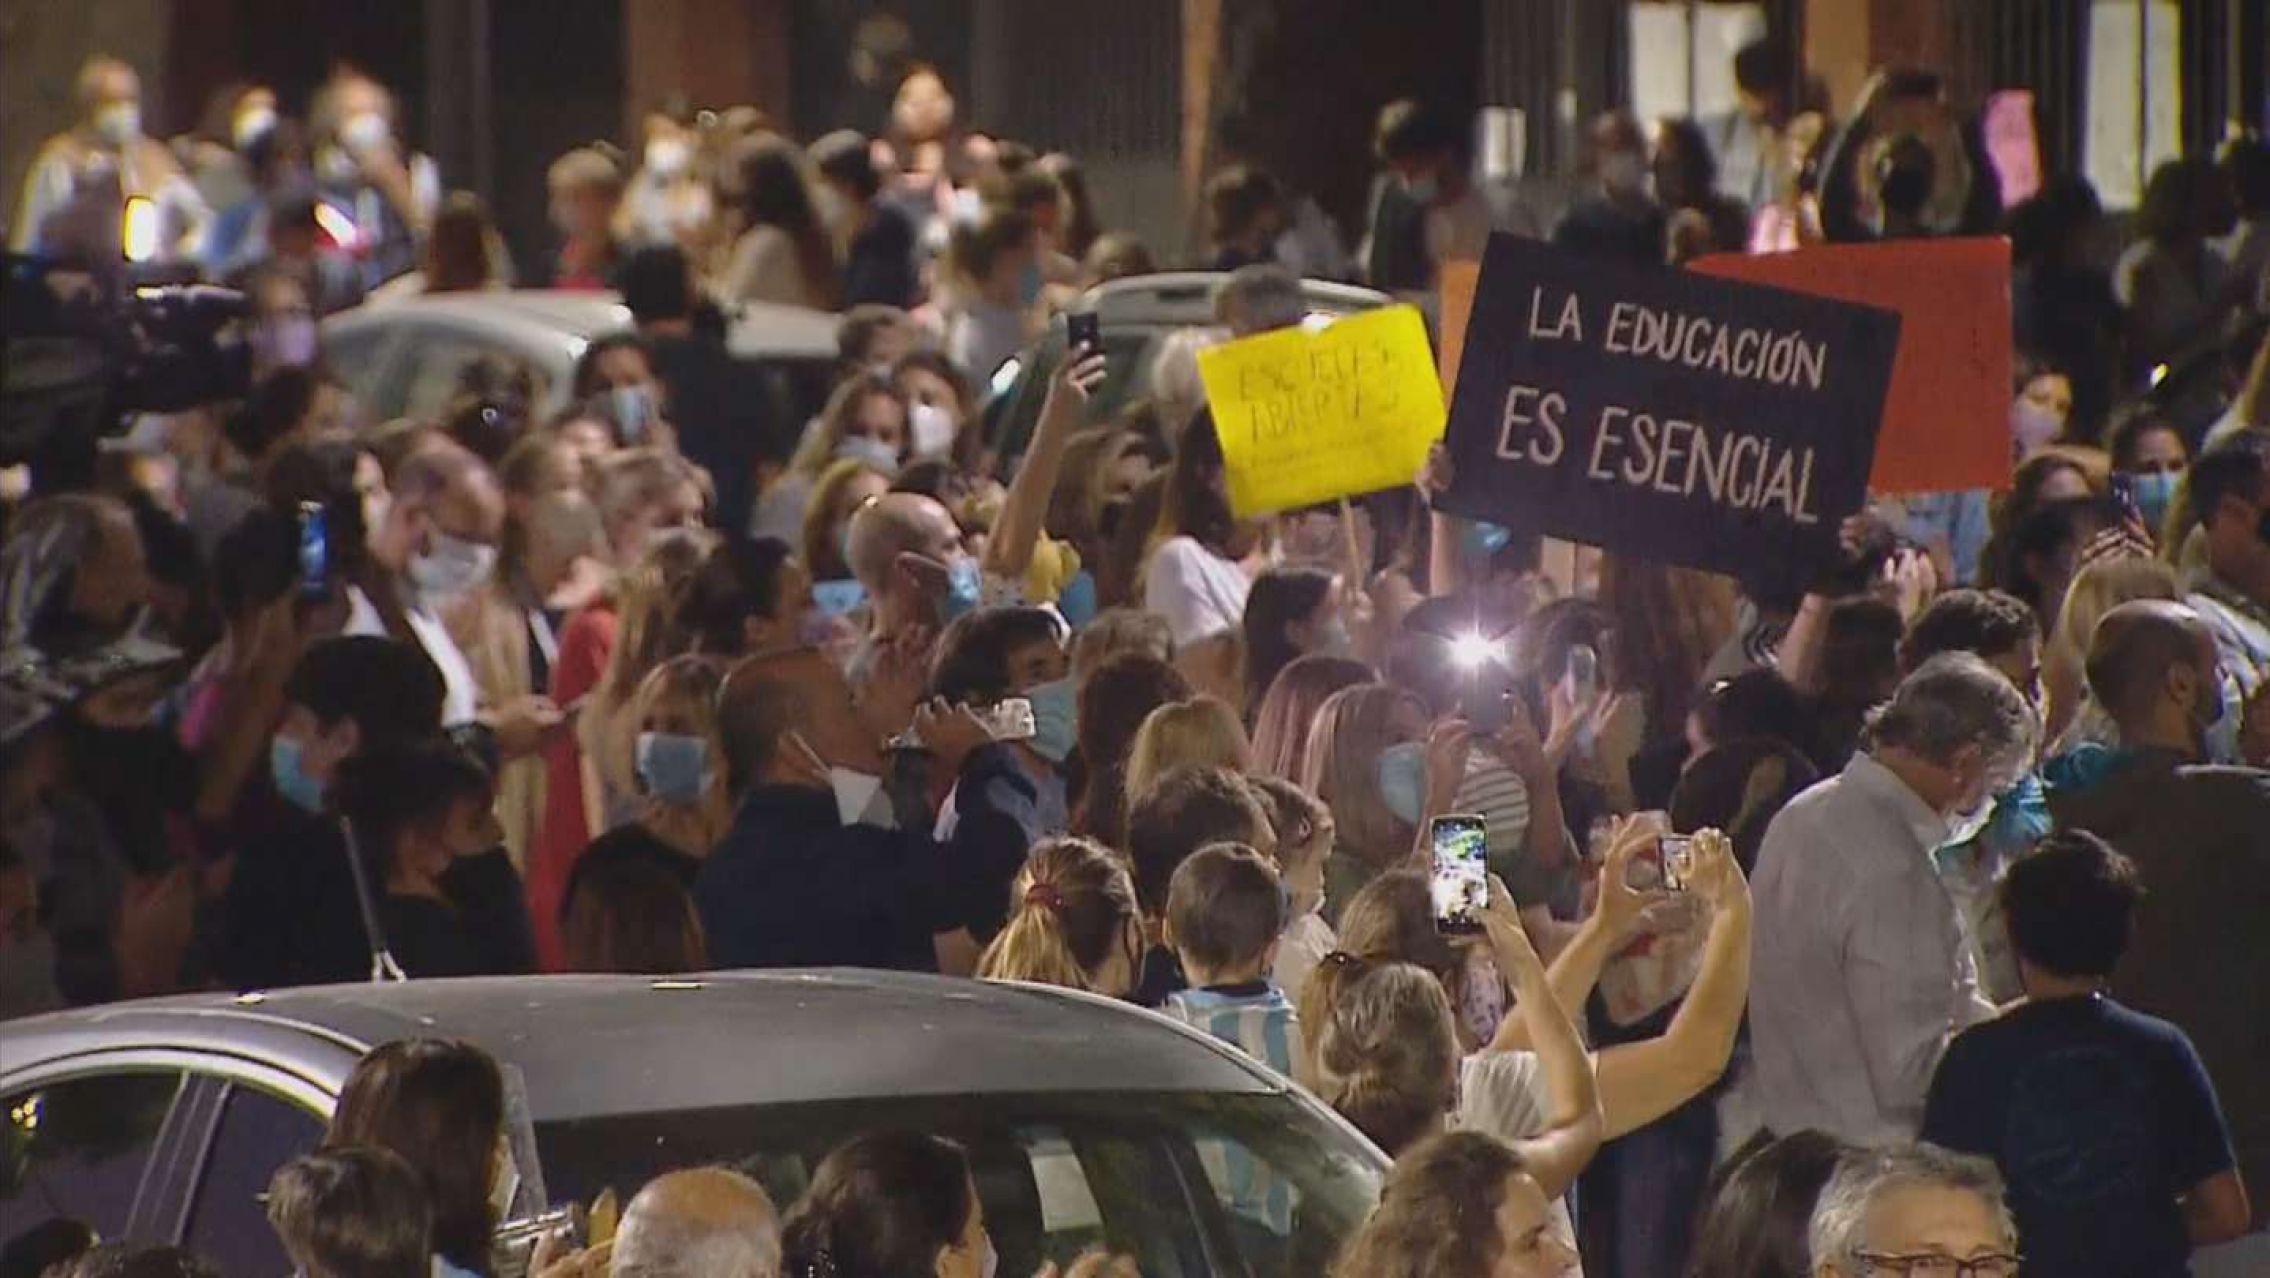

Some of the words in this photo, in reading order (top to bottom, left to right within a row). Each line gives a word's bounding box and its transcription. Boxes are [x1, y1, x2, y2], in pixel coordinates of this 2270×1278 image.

[1527, 285, 1583, 343] LA
[1604, 301, 1828, 390] EDUCACIÓN
[1496, 385, 1568, 466] ES
[1586, 406, 1820, 524] ESENCIAL
